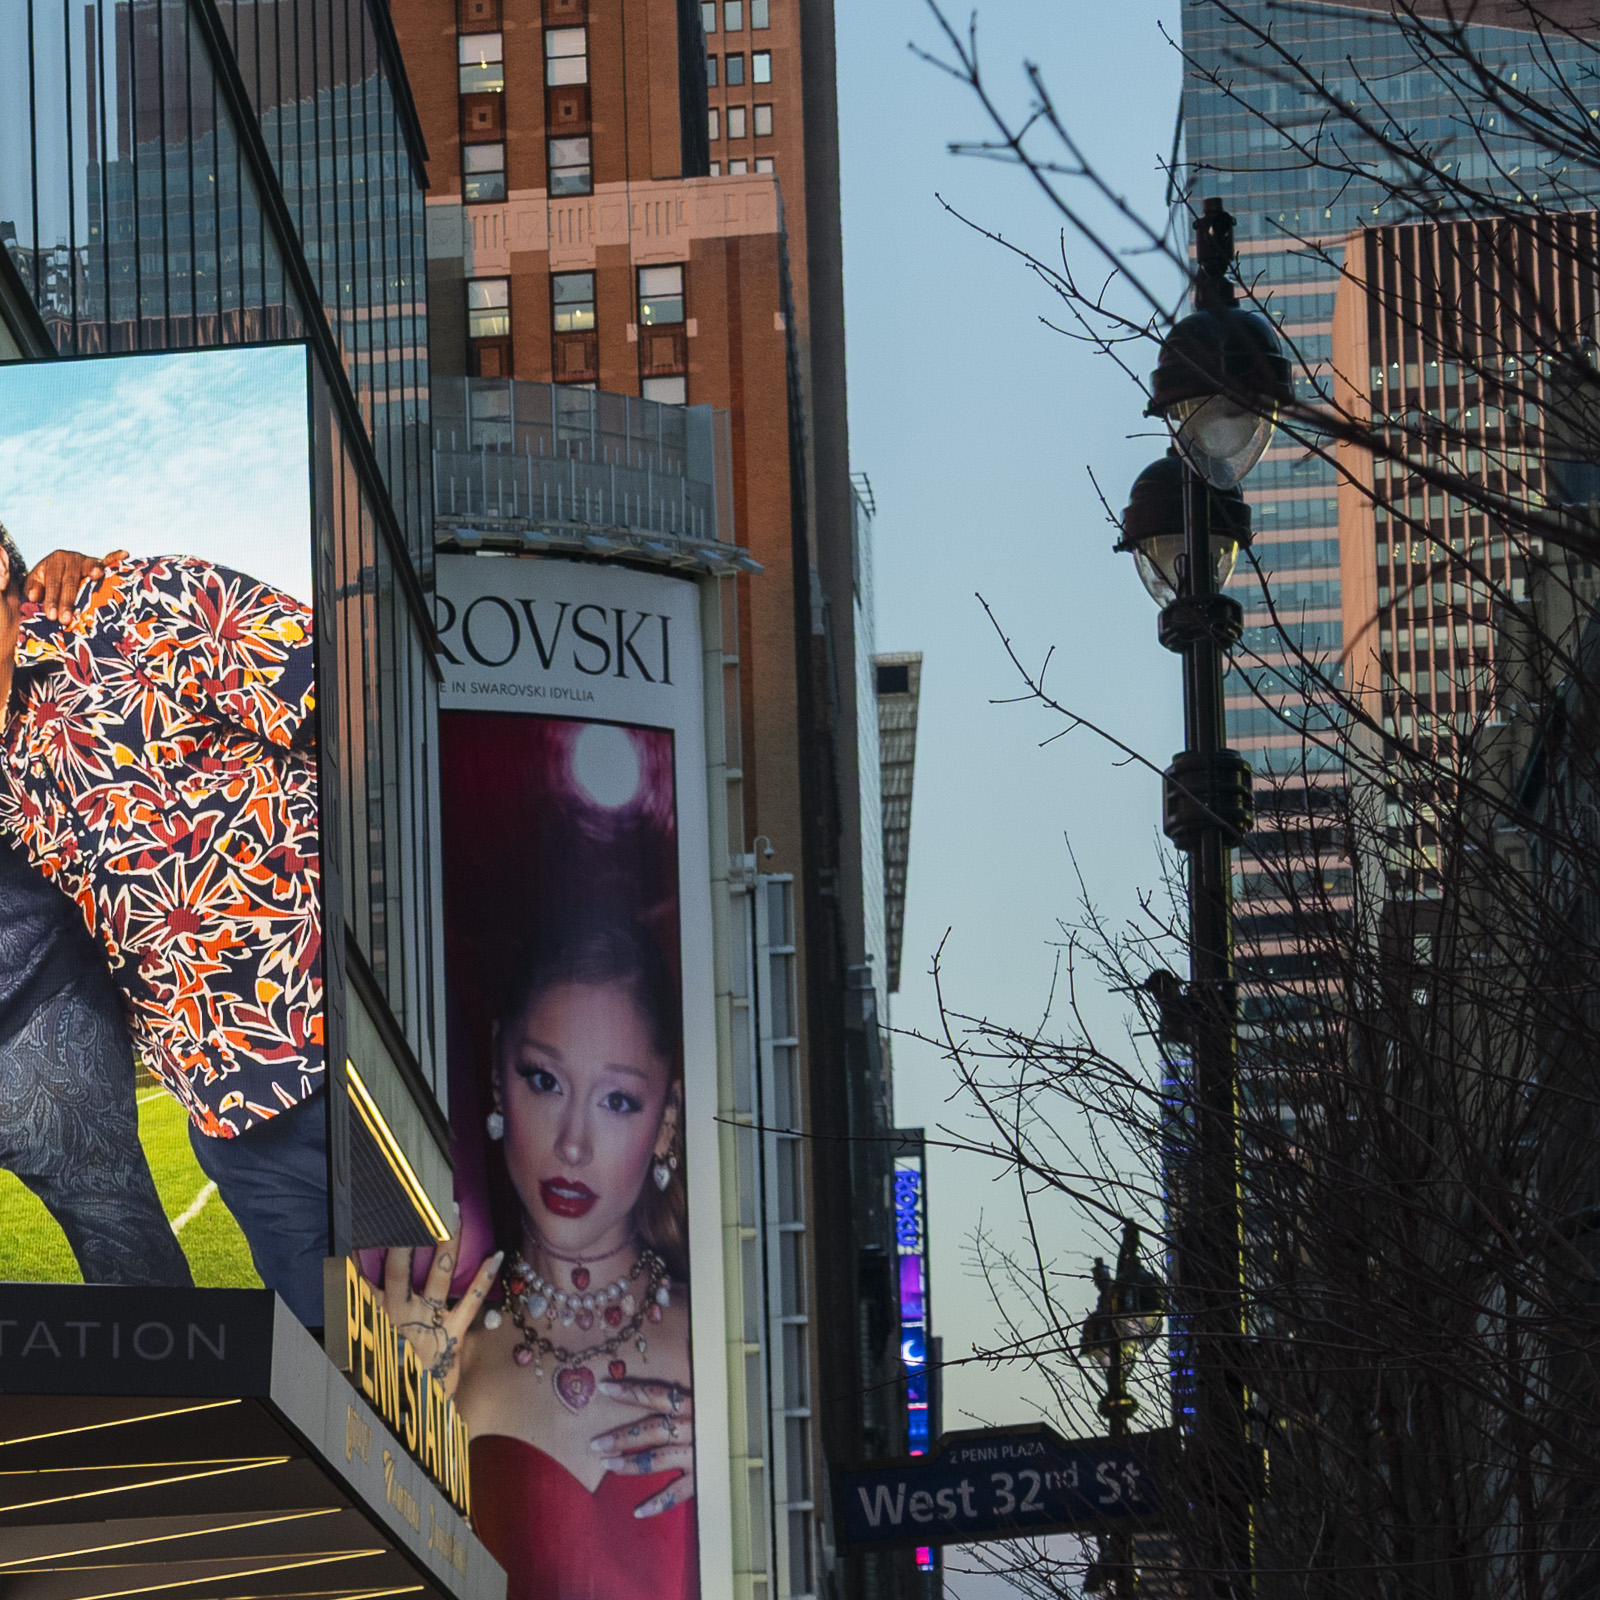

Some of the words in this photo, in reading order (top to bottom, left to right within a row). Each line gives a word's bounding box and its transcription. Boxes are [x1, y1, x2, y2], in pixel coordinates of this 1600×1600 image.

[451, 682, 466, 694] IN
[470, 682, 547, 698] SWAROVSKI
[550, 687, 595, 702] IDYLLIA
[345, 1255, 400, 1434] PENN
[404, 1337, 471, 1518] STATION
[961, 1447, 998, 1462] PENN
[1001, 1442, 1047, 1459] PLAZA
[857, 1478, 978, 1528] West
[990, 1461, 1080, 1515] 32nd
[1095, 1461, 1143, 1505] St
